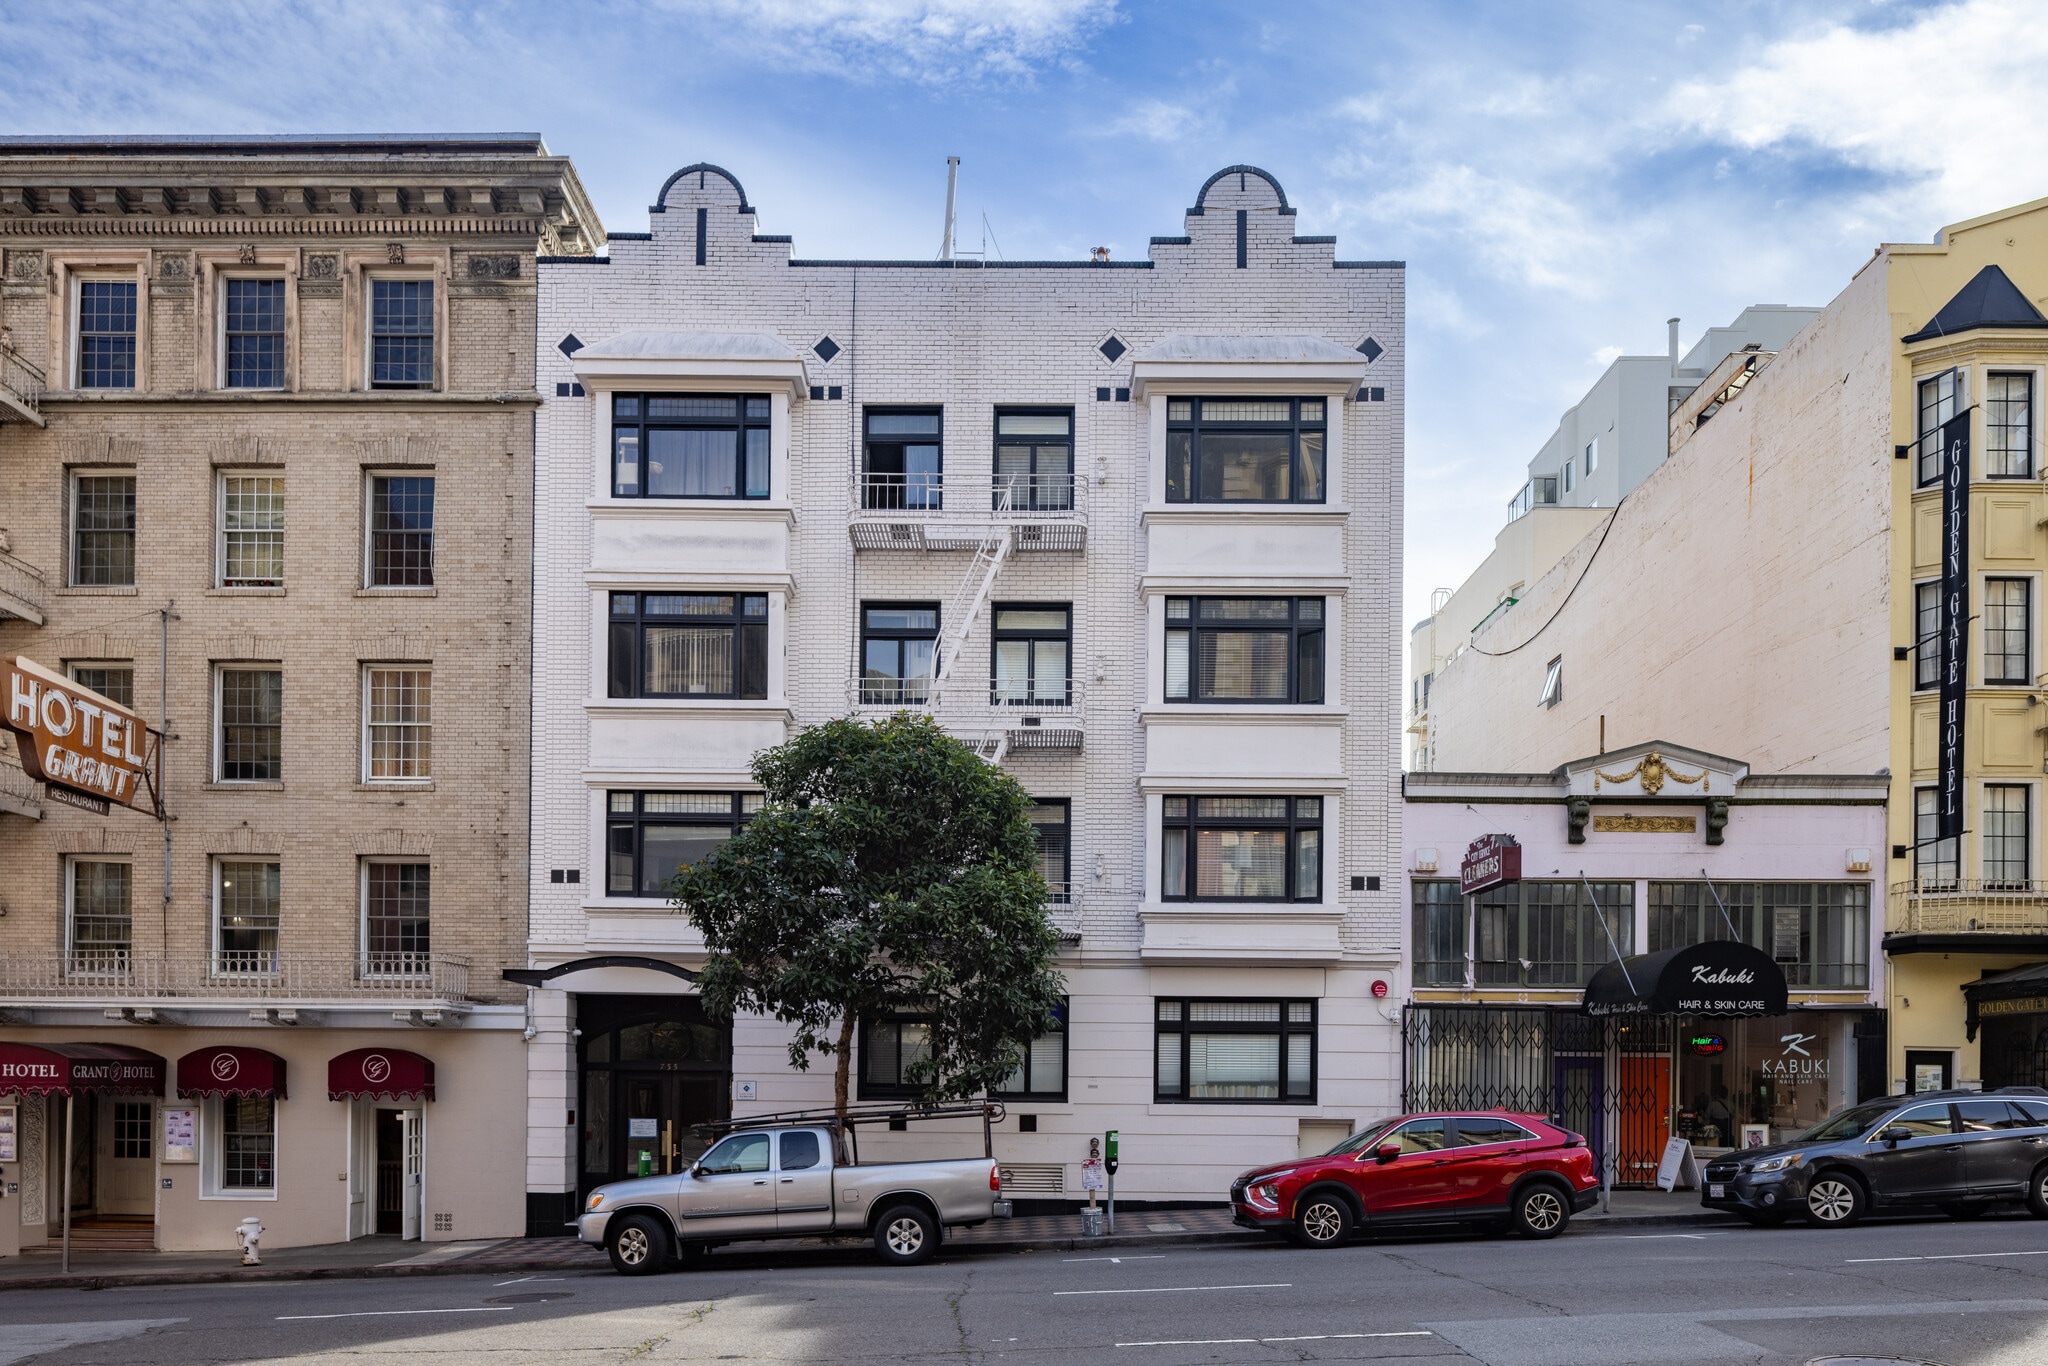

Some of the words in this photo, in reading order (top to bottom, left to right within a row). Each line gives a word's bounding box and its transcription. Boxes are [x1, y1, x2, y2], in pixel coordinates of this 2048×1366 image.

[1950, 439, 1961, 578] GOLDEN
[1949, 592, 1960, 685] GATE
[11, 672, 144, 767] HOTEL
[1946, 699, 1957, 815] HOTEL
[45, 744, 131, 796] GRANT
[51, 787, 105, 812] RESTAURANT
[1464, 856, 1499, 884] CLEANERS
[1691, 965, 1755, 984] Kabuki
[1679, 1000, 1701, 1009] HAIR
[1704, 1000, 1712, 1009] &
[1714, 1000, 1736, 1010] SKIN
[1738, 1000, 1765, 1010] CARE
[1979, 1001, 2014, 1014] GOLDEN
[2016, 999, 2041, 1012] GATE
[1692, 1037, 1712, 1045] Hair
[2, 1064, 59, 1078] HOTEL
[73, 1065, 109, 1078] GRANT
[123, 1066, 155, 1078] HOTEL
[660, 1063, 678, 1071] 755
[1762, 1060, 1830, 1074] KABUKI
[244, 1246, 250, 1255] 2
